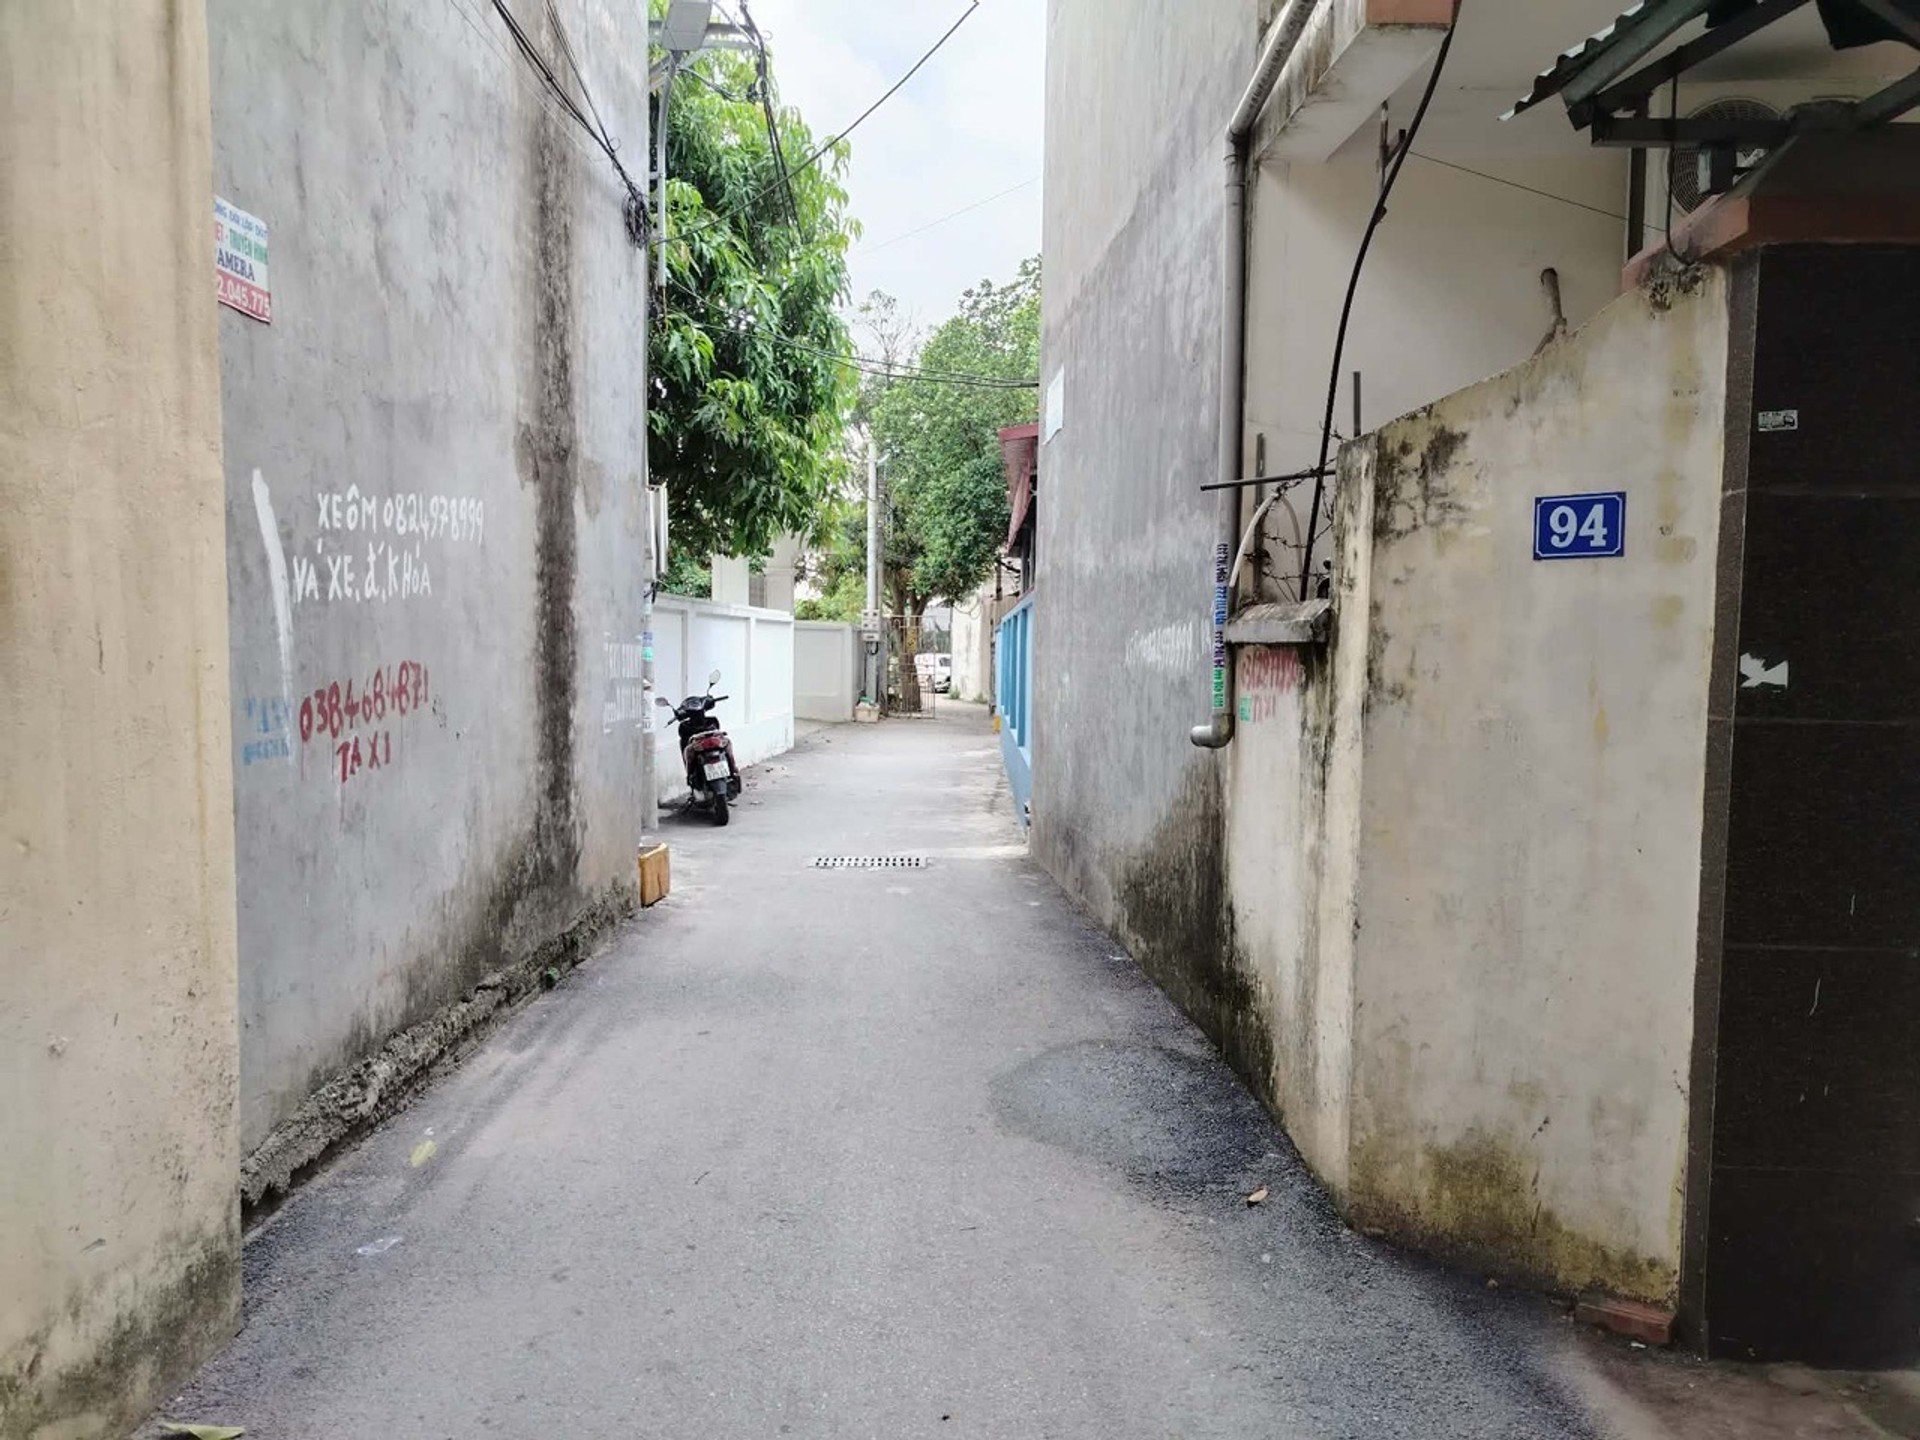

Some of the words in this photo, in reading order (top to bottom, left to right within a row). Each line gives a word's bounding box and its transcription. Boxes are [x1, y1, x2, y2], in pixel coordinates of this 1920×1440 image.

[217, 248, 255, 281] AMERA
[1549, 503, 1608, 548] 94
[336, 730, 392, 783] TAXI
